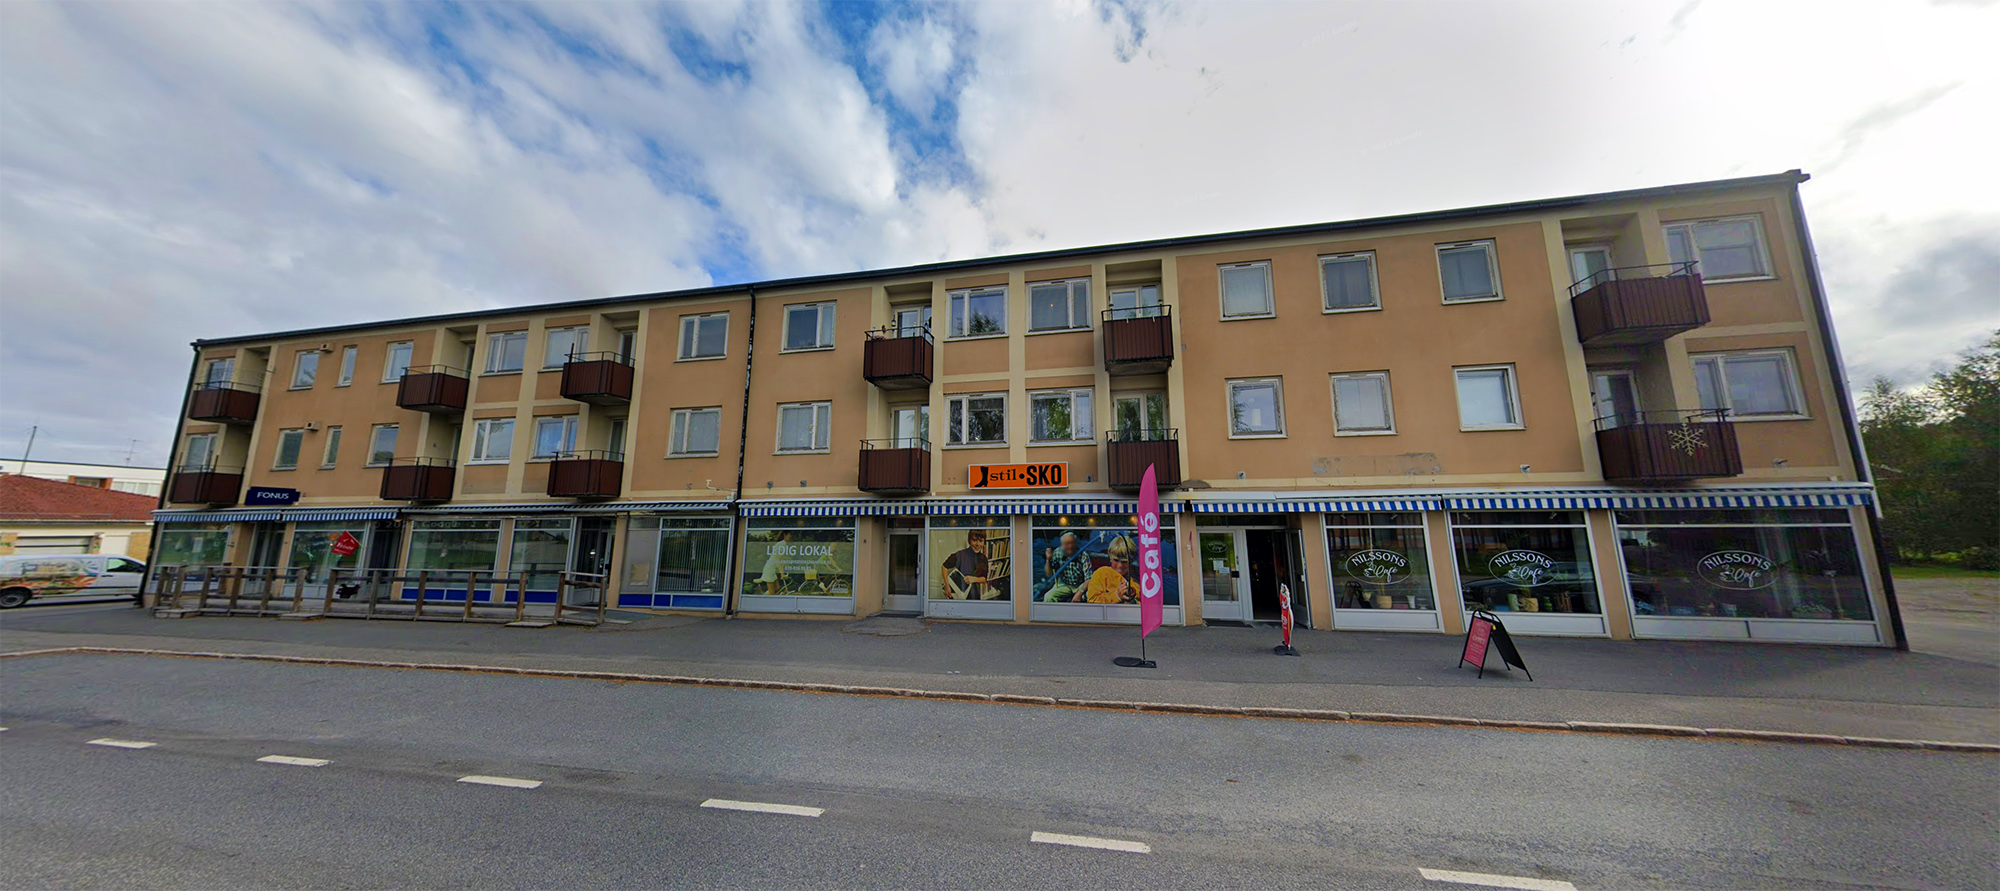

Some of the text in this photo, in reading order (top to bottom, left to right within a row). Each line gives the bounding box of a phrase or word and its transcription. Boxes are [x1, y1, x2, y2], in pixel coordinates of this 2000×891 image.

[990, 464, 1062, 486] stil SKO
[256, 491, 289, 500] FONUS
[766, 545, 834, 556] LEDIG LOKAL
[1140, 511, 1161, 599] Café
[1351, 551, 1406, 567] NILSSONS
[1494, 552, 1552, 569] NILSSONS
[1704, 553, 1771, 571] NILSSONS
